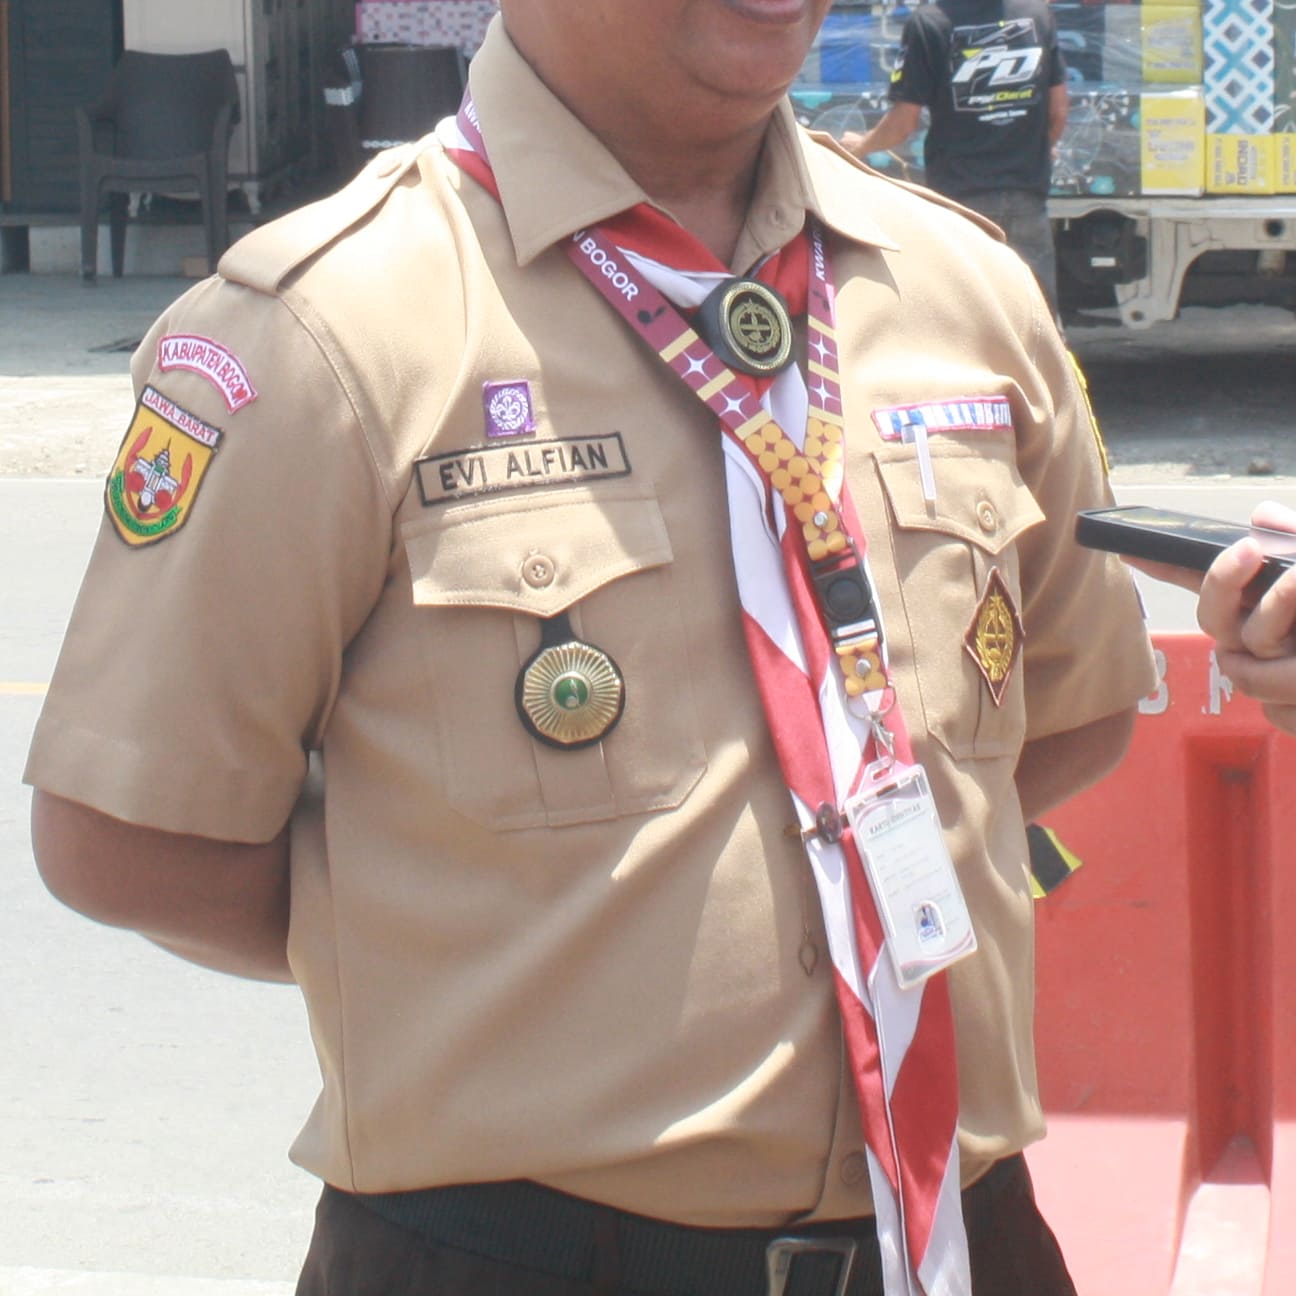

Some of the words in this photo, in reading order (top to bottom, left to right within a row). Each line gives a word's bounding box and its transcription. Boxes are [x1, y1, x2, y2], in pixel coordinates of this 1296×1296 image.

[579, 237, 640, 302] BOGOR
[144, 387, 177, 420] JAWA
[177, 409, 218, 444] BARAT
[438, 456, 488, 491] EVI
[505, 442, 608, 480] ALFIAN
